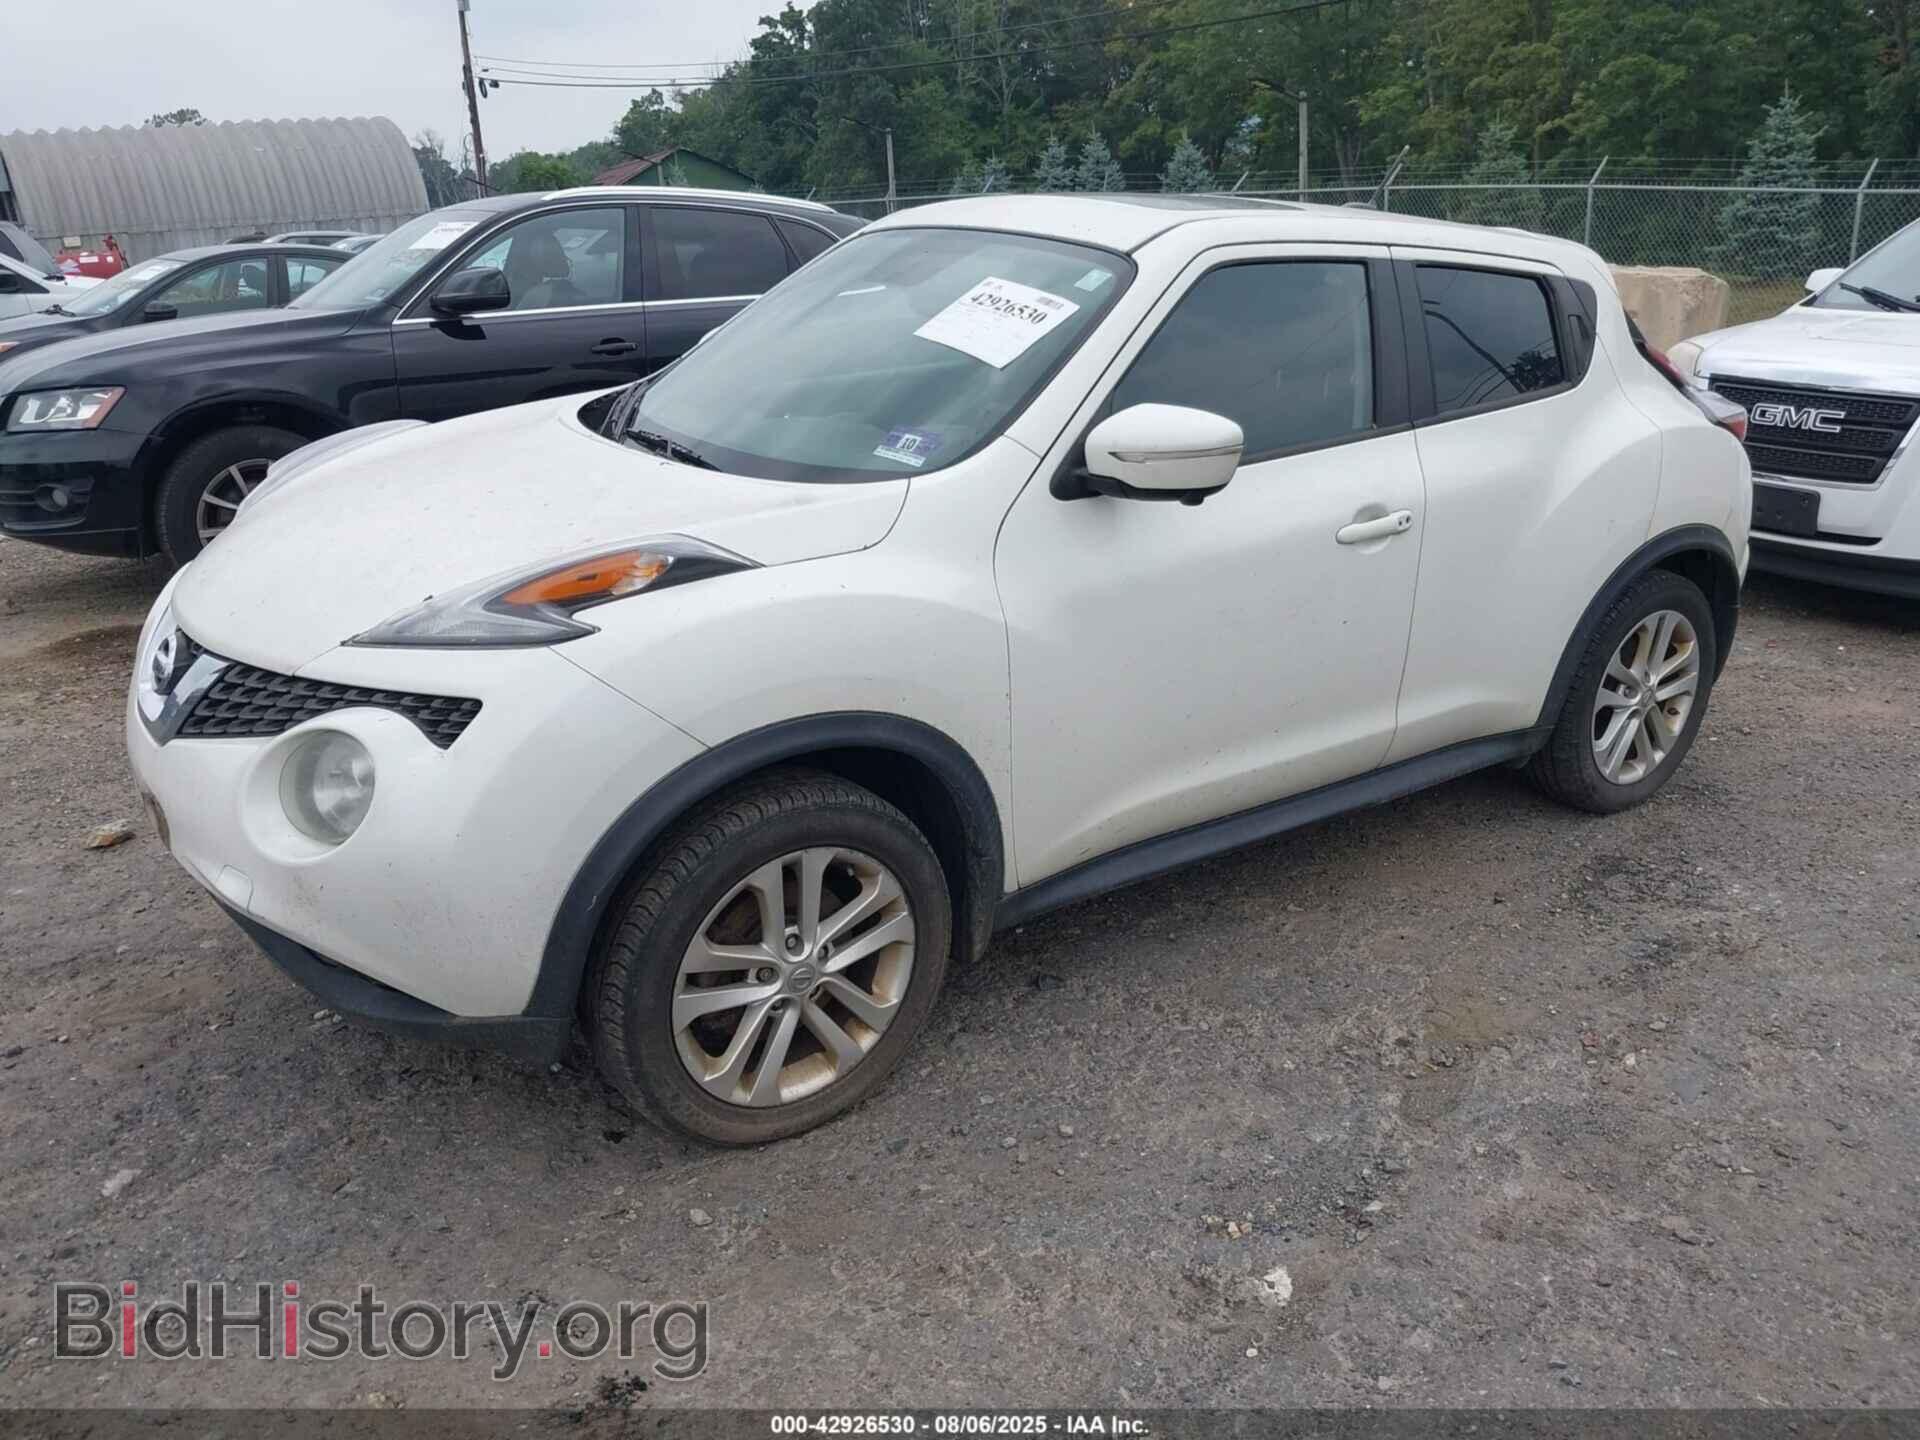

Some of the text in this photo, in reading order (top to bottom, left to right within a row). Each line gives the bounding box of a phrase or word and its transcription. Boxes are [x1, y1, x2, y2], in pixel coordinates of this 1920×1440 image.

[971, 292, 1047, 325] 42926530
[1751, 403, 1846, 433] GMC
[902, 437, 918, 450] 10
